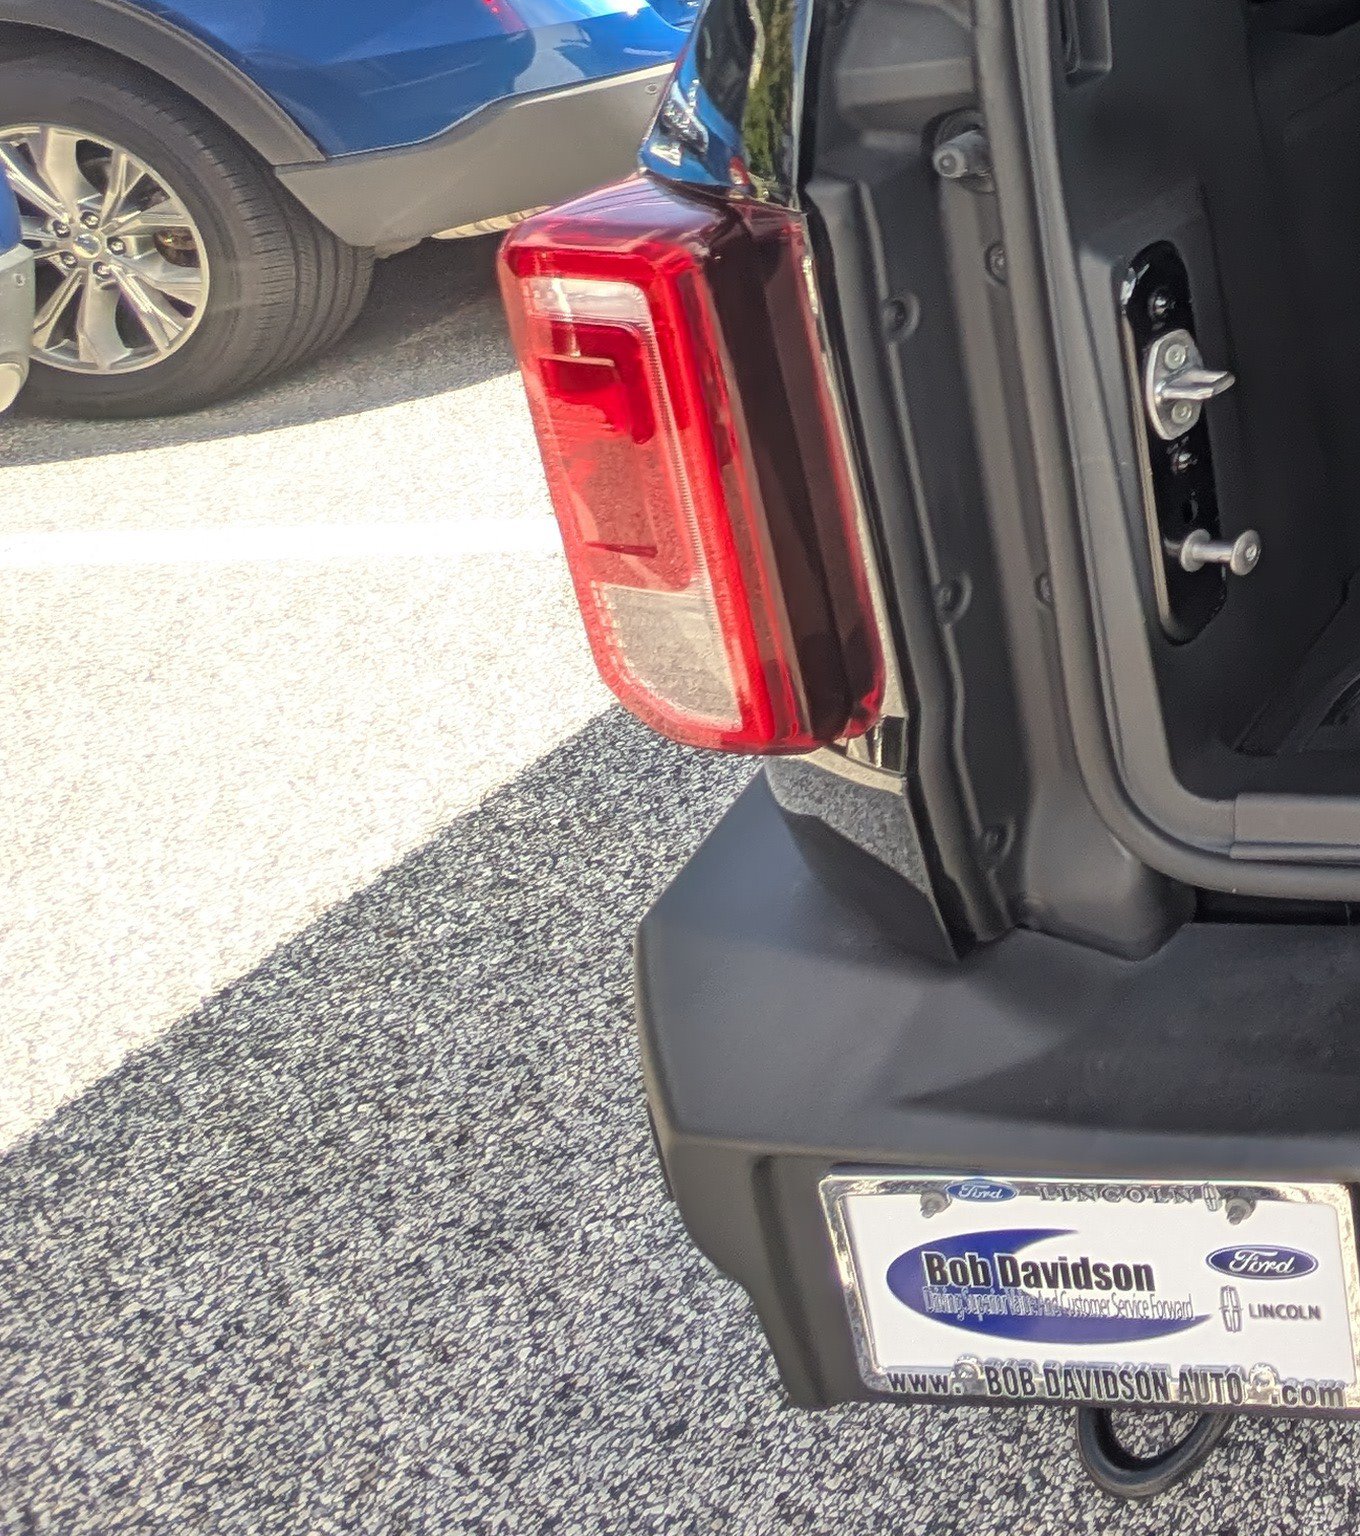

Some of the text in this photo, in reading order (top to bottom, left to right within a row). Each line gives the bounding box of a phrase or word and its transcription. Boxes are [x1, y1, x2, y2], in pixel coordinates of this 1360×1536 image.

[957, 1183, 1196, 1204] Ford LINCOLN
[922, 1251, 1156, 1292] Bob Davidson
[1228, 1249, 1296, 1274] Ford
[1111, 1292, 1149, 1319] Service
[1149, 1292, 1195, 1321] Forward
[1247, 1302, 1322, 1321] LINCOLN
[886, 1364, 1348, 1409] www. BOB DAVIDSON AUTO .com
